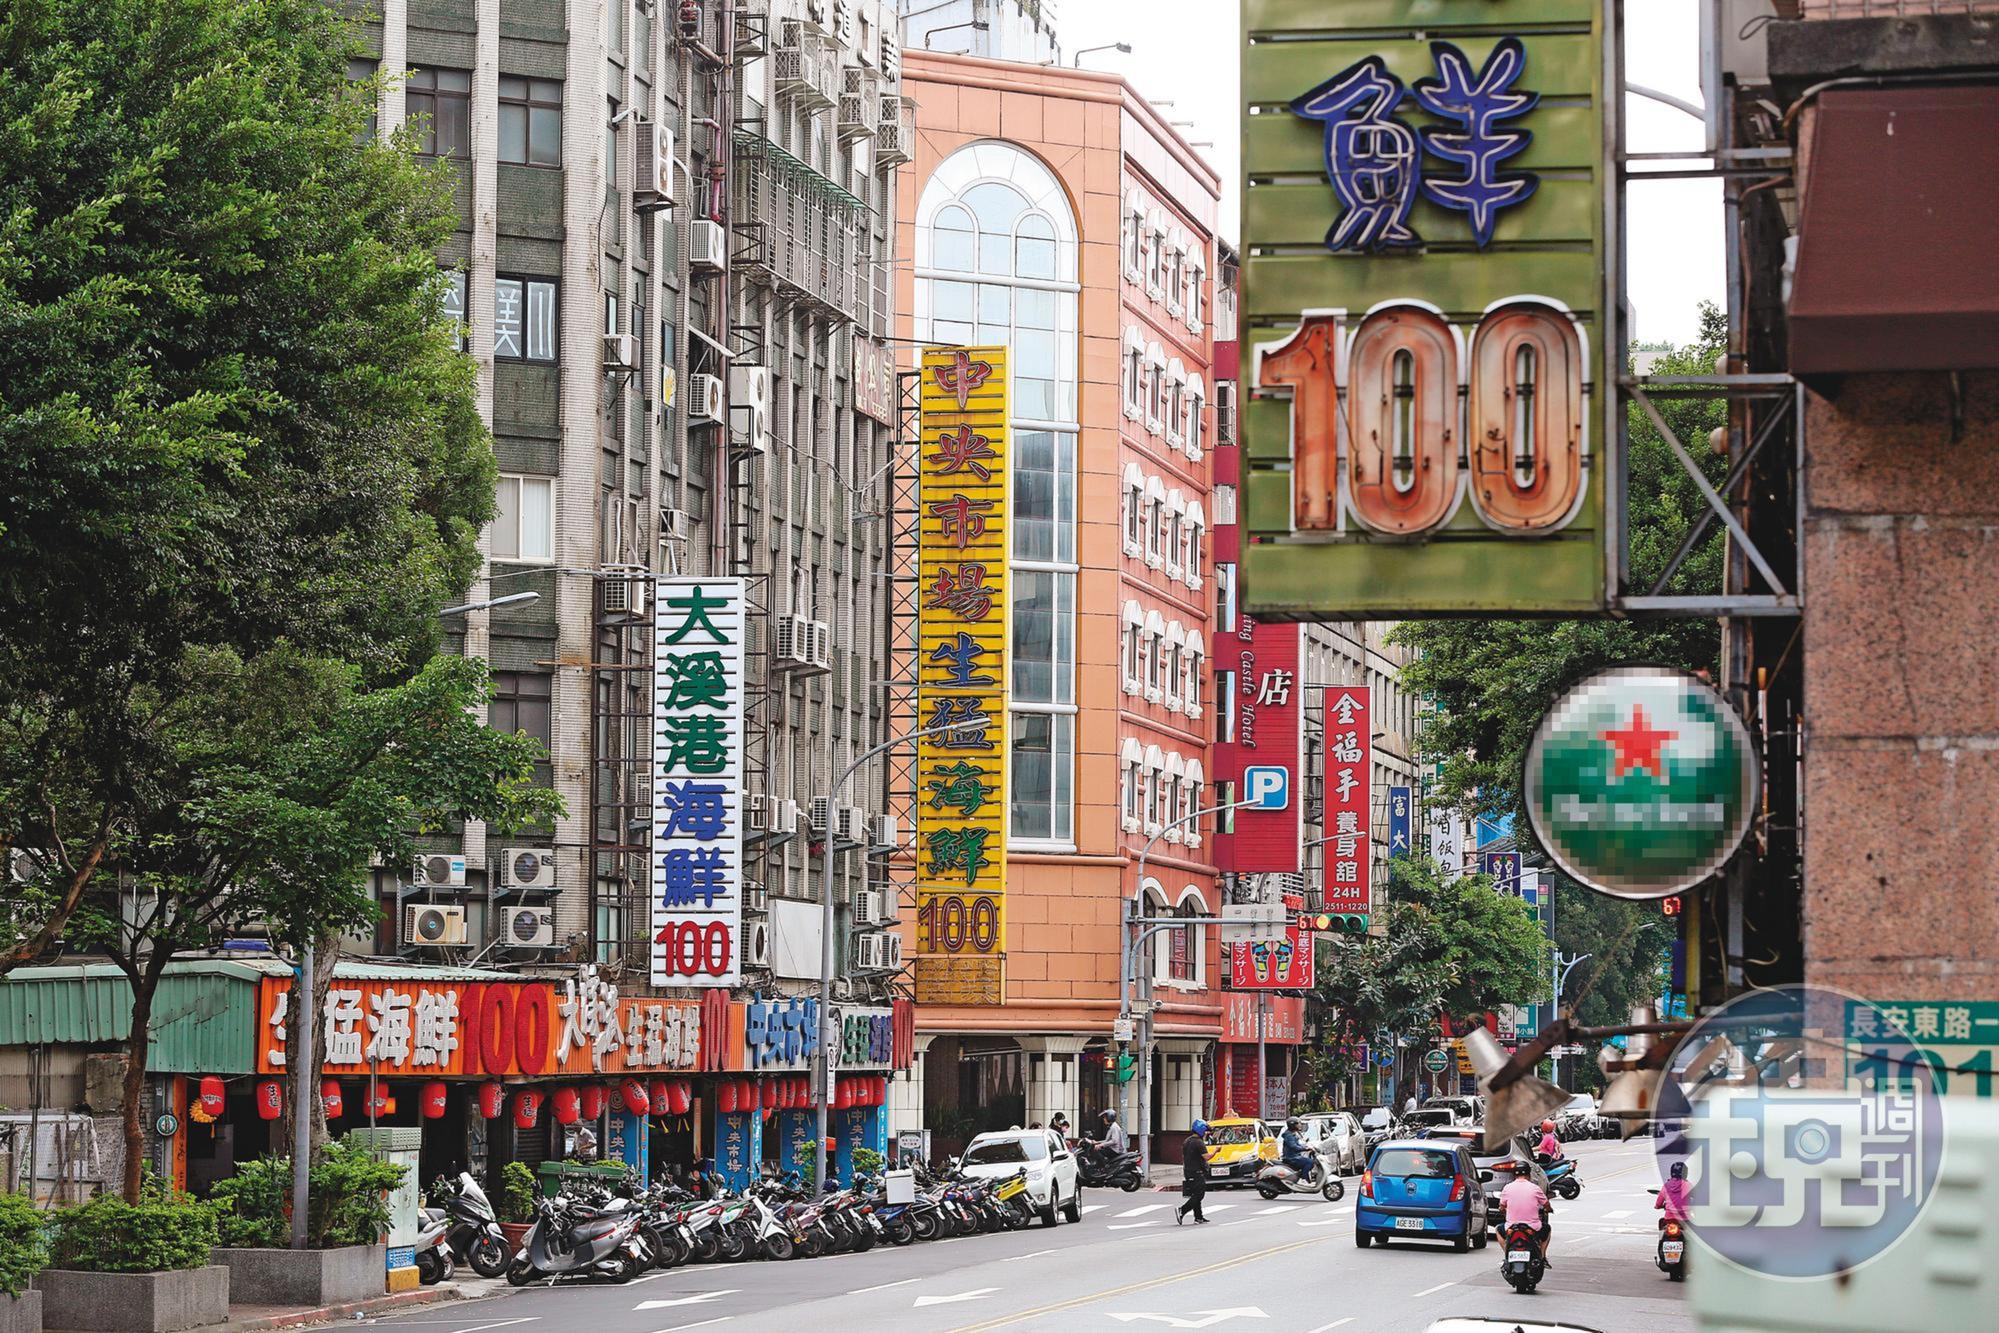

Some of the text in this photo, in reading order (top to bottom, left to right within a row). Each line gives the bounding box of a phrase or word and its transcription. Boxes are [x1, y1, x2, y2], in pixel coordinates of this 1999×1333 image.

[1289, 36, 1541, 251] 鮮
[1253, 294, 1590, 537] 100
[1240, 651, 1256, 696] Castle
[1256, 669, 1293, 706] 店
[662, 584, 729, 908] 大溪港海鮮
[1241, 703, 1256, 748] Hotel
[1333, 887, 1360, 898] 24H
[656, 921, 729, 977] 100
[918, 896, 997, 953] 100
[462, 983, 550, 1076] 100
